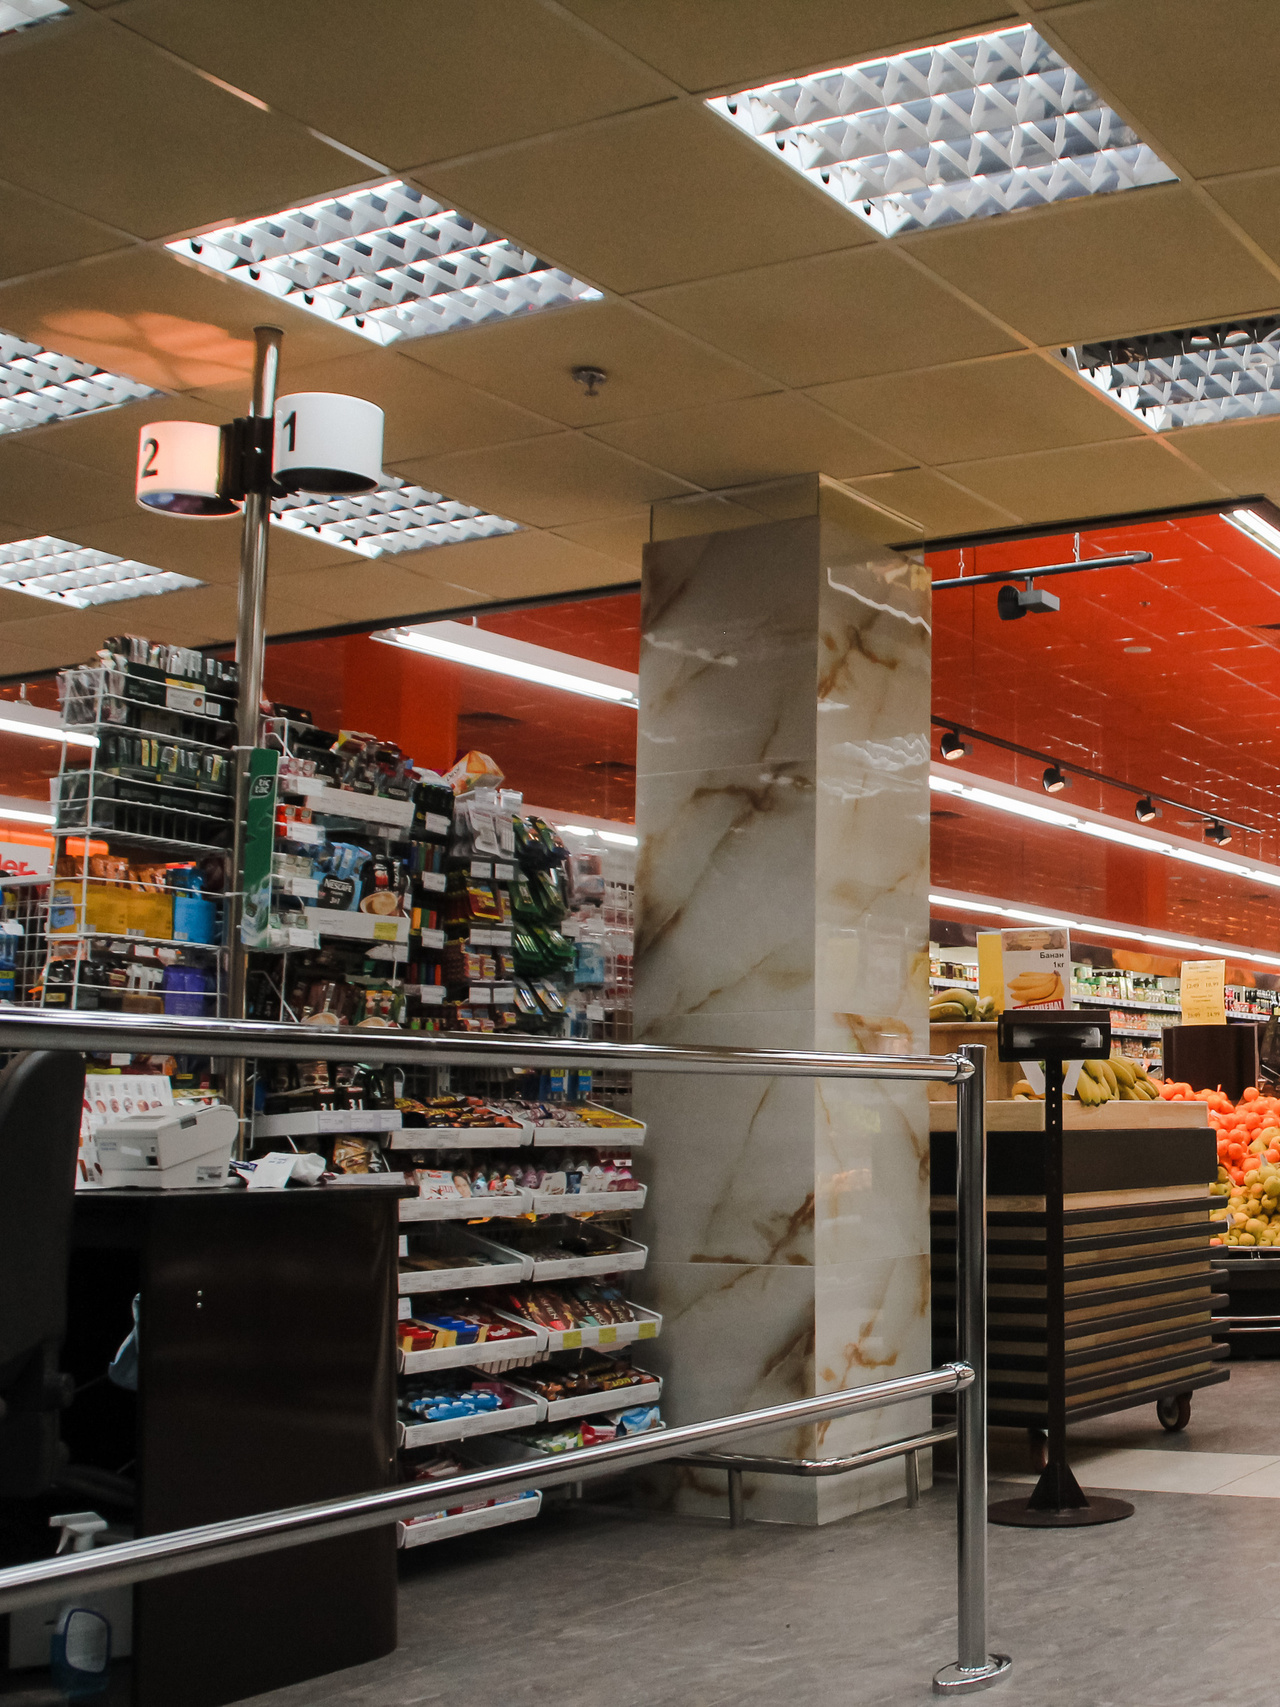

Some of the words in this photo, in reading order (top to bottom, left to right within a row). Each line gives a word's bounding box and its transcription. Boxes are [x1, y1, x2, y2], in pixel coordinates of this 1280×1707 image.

[282, 410, 297, 452] 1
[141, 438, 159, 478] 2
[258, 777, 272, 787] tic
[1040, 951, 1064, 959] Банан
